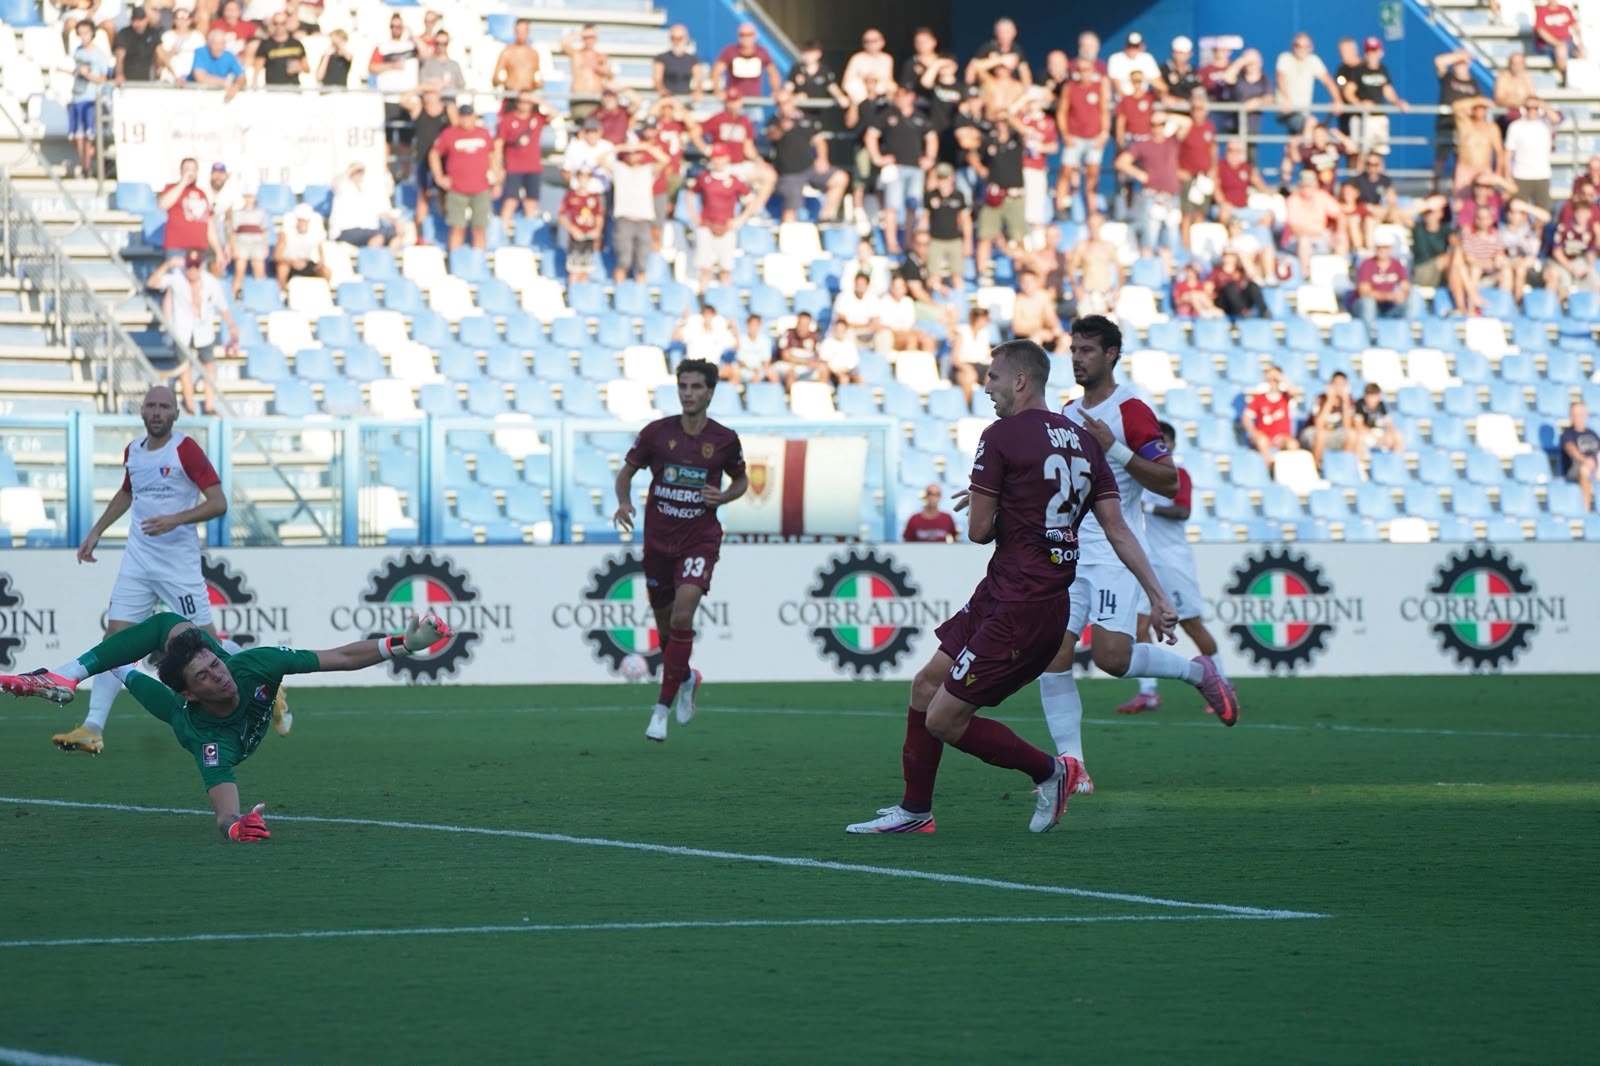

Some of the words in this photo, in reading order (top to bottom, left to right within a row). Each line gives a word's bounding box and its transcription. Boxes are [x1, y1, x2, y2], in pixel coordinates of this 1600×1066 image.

[1043, 453, 1092, 528] 25
[682, 556, 705, 578] 33
[178, 594, 196, 616] 18
[778, 601, 951, 627] CORRADINI
[1099, 589, 1117, 614] 14
[1400, 597, 1567, 622] CORRADINI
